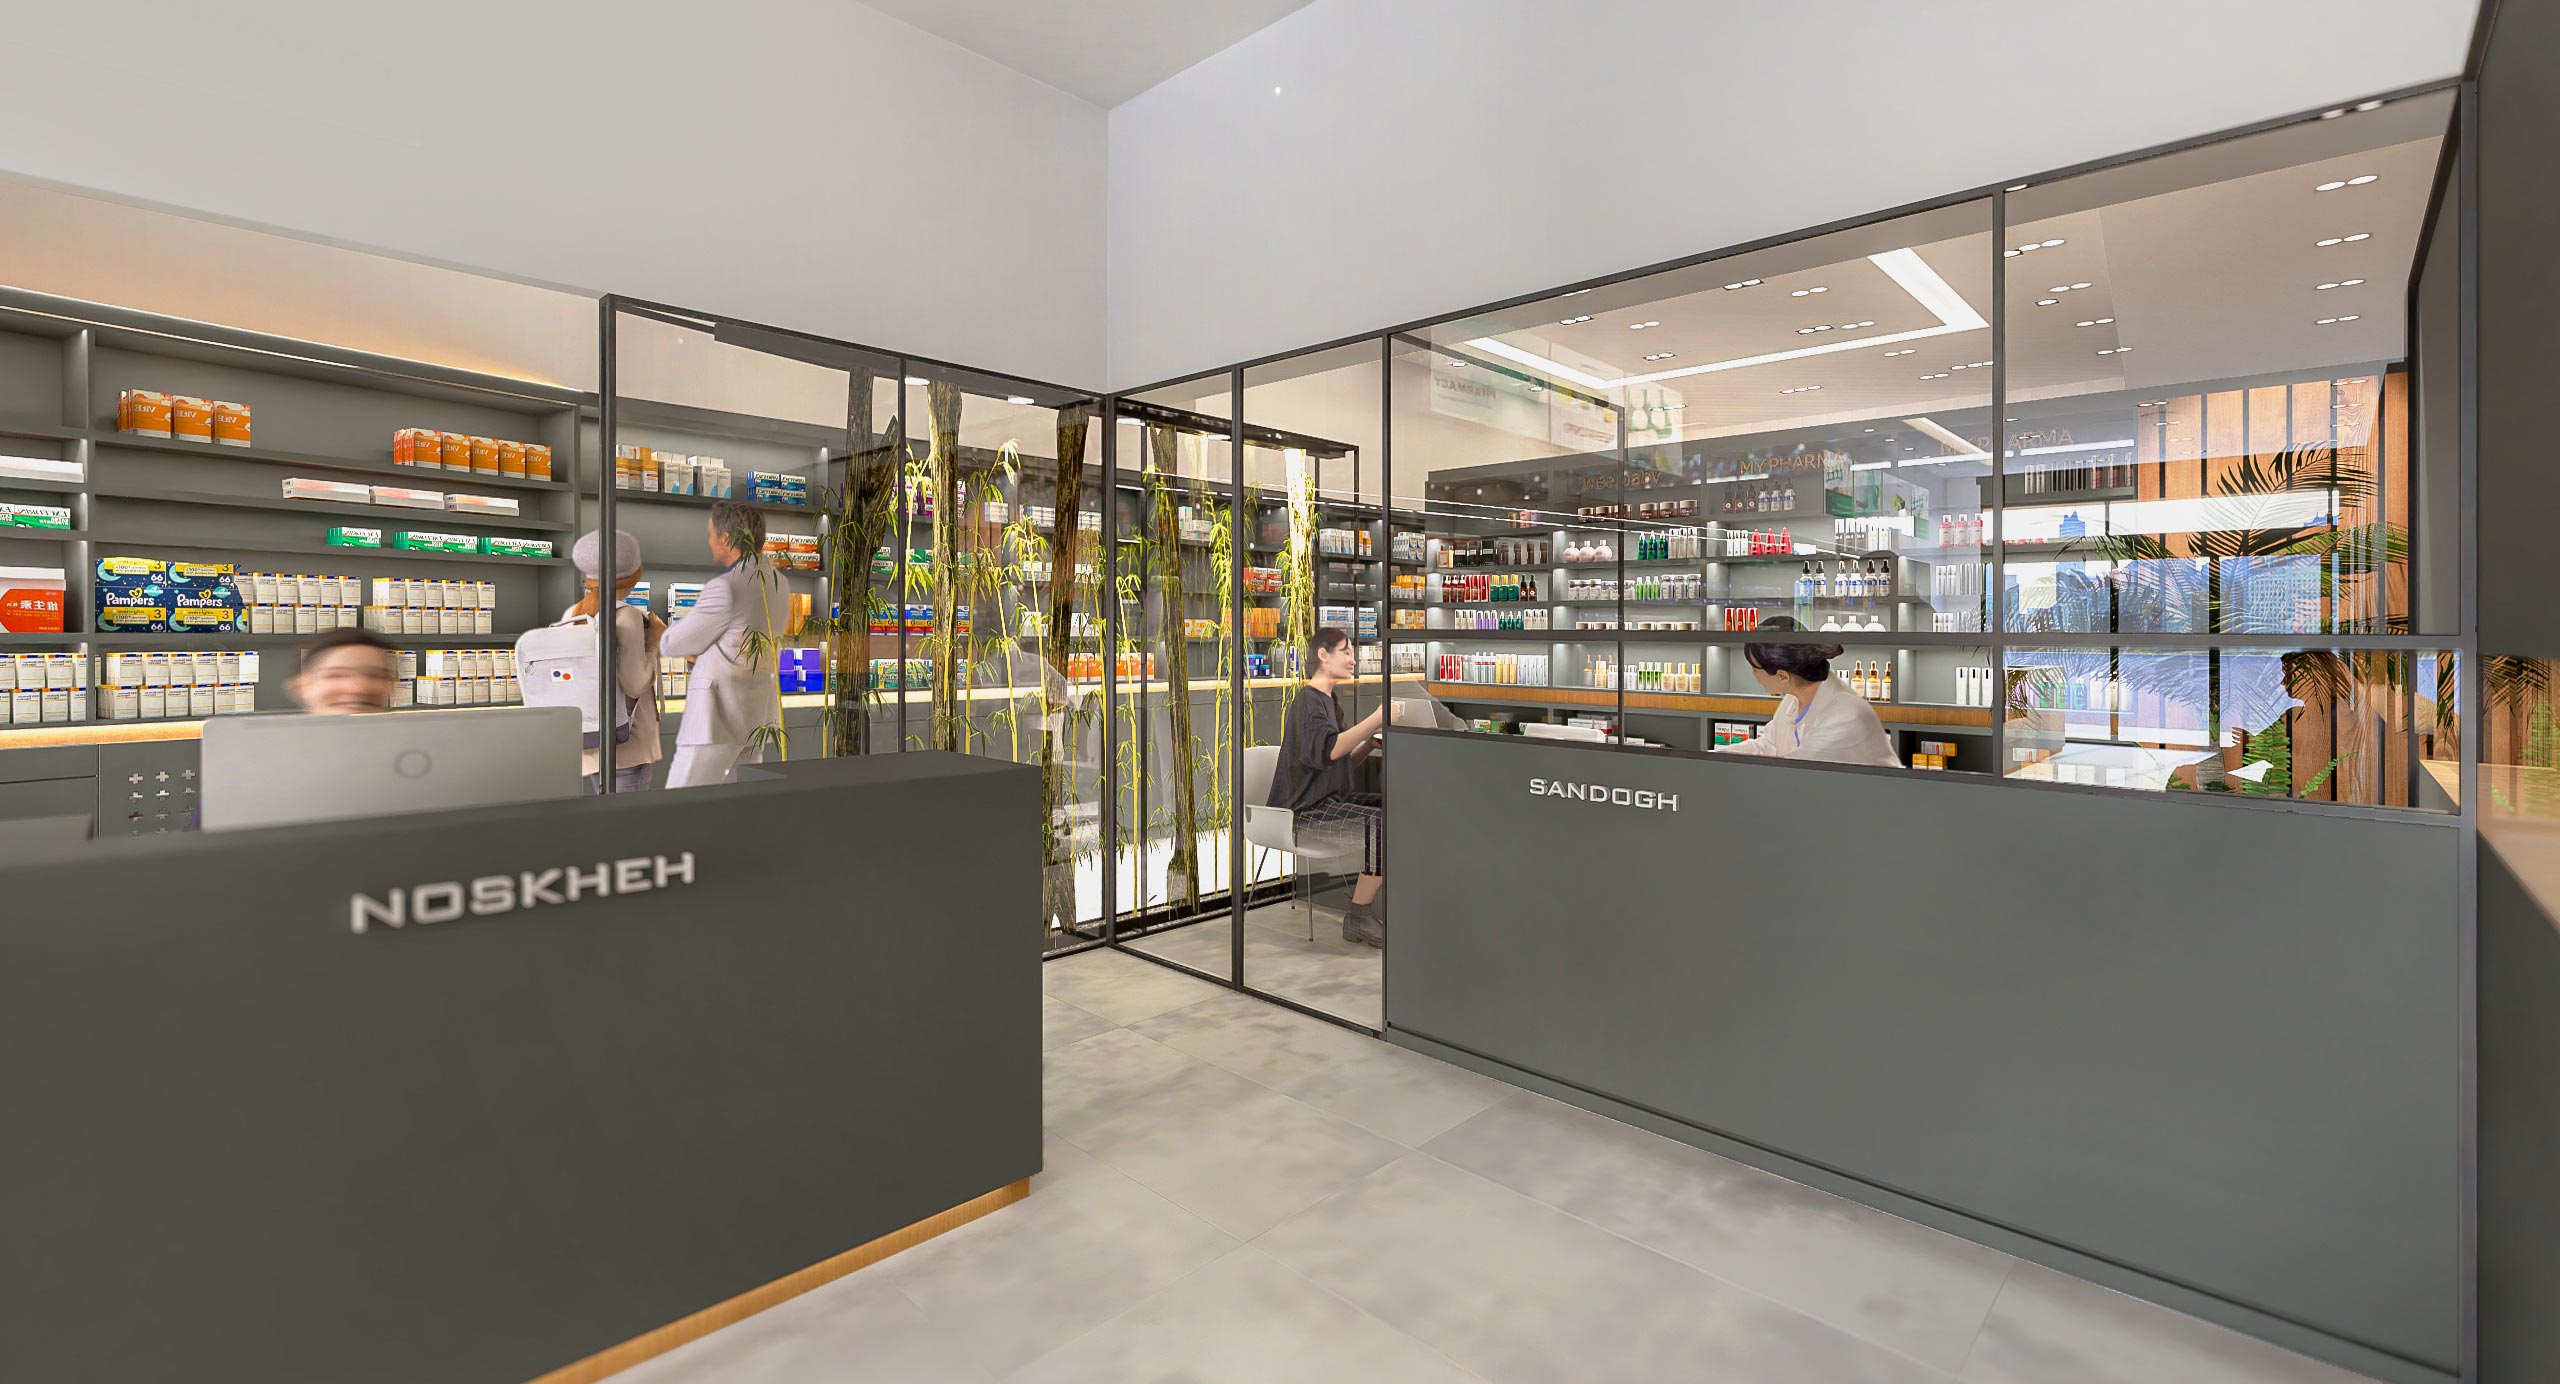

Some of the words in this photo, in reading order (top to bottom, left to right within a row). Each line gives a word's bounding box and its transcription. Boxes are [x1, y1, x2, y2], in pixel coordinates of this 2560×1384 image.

[1978, 426, 2074, 450] PARMA
[1739, 458, 1766, 475] MY
[1768, 449, 1844, 472] PHARMA
[151, 573, 163, 581] 66
[219, 575, 231, 583] 66
[105, 592, 155, 607] Pampers
[176, 593, 223, 608] Pampers
[153, 609, 162, 619] 3
[222, 610, 230, 620] 3
[151, 623, 163, 631] 66
[219, 623, 231, 631] 66
[1529, 777, 1680, 812] SANDOGH
[350, 851, 695, 934] NOSKHEH
